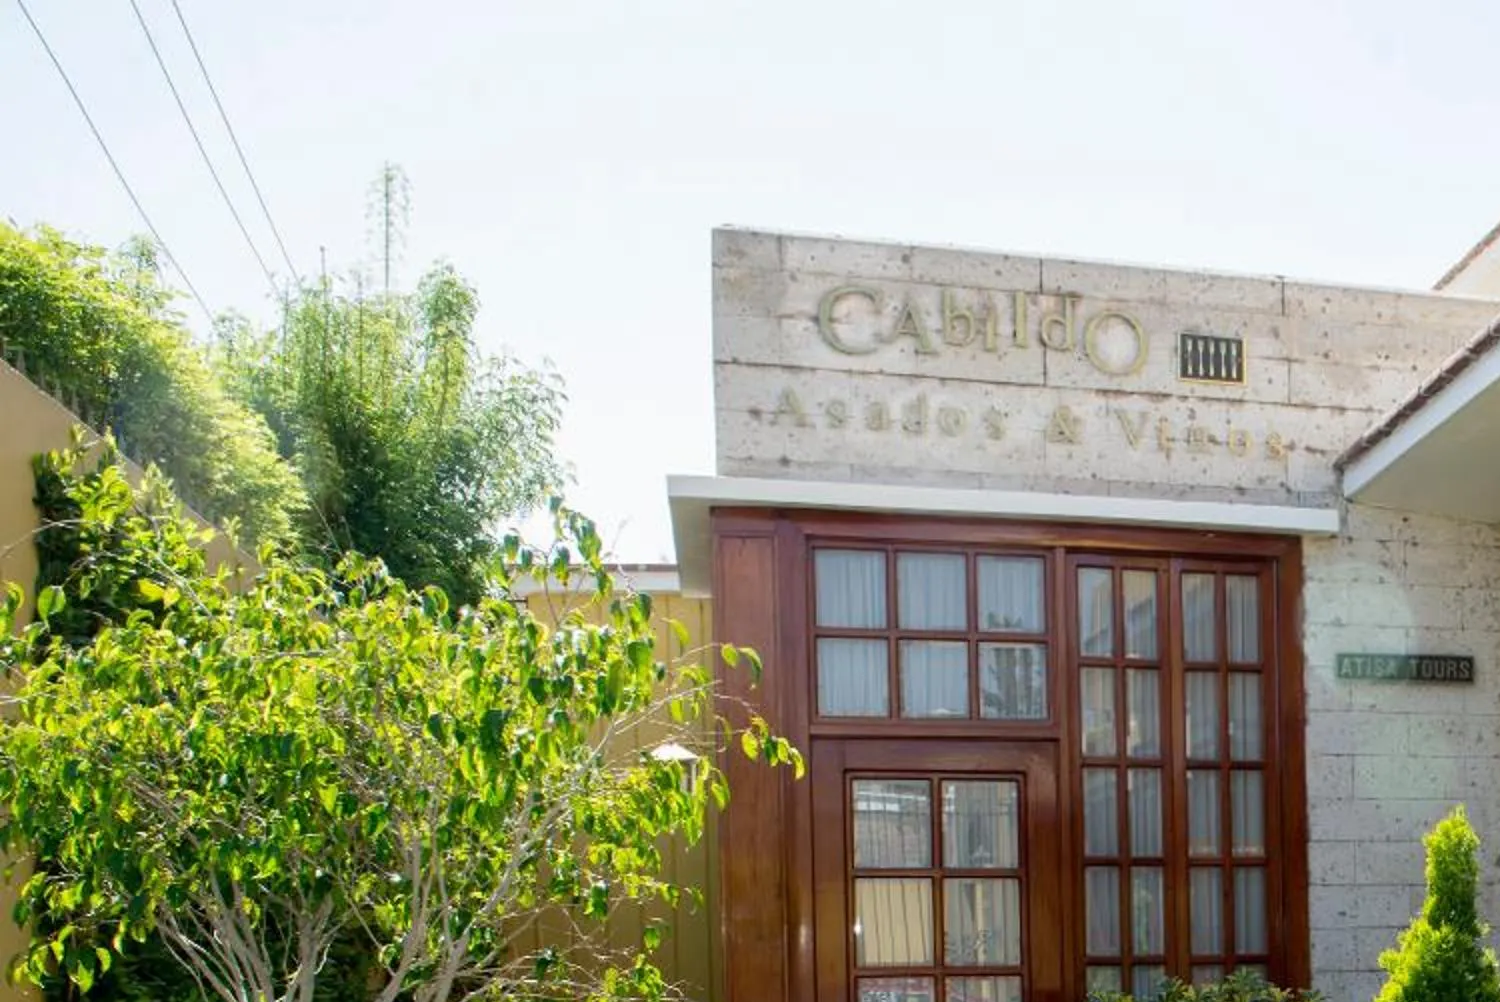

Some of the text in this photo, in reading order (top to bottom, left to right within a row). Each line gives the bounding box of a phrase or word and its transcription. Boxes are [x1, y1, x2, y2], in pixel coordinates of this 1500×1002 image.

[773, 386, 1008, 442] Asados
[1046, 405, 1085, 446] &
[1407, 659, 1471, 680] TOURS
